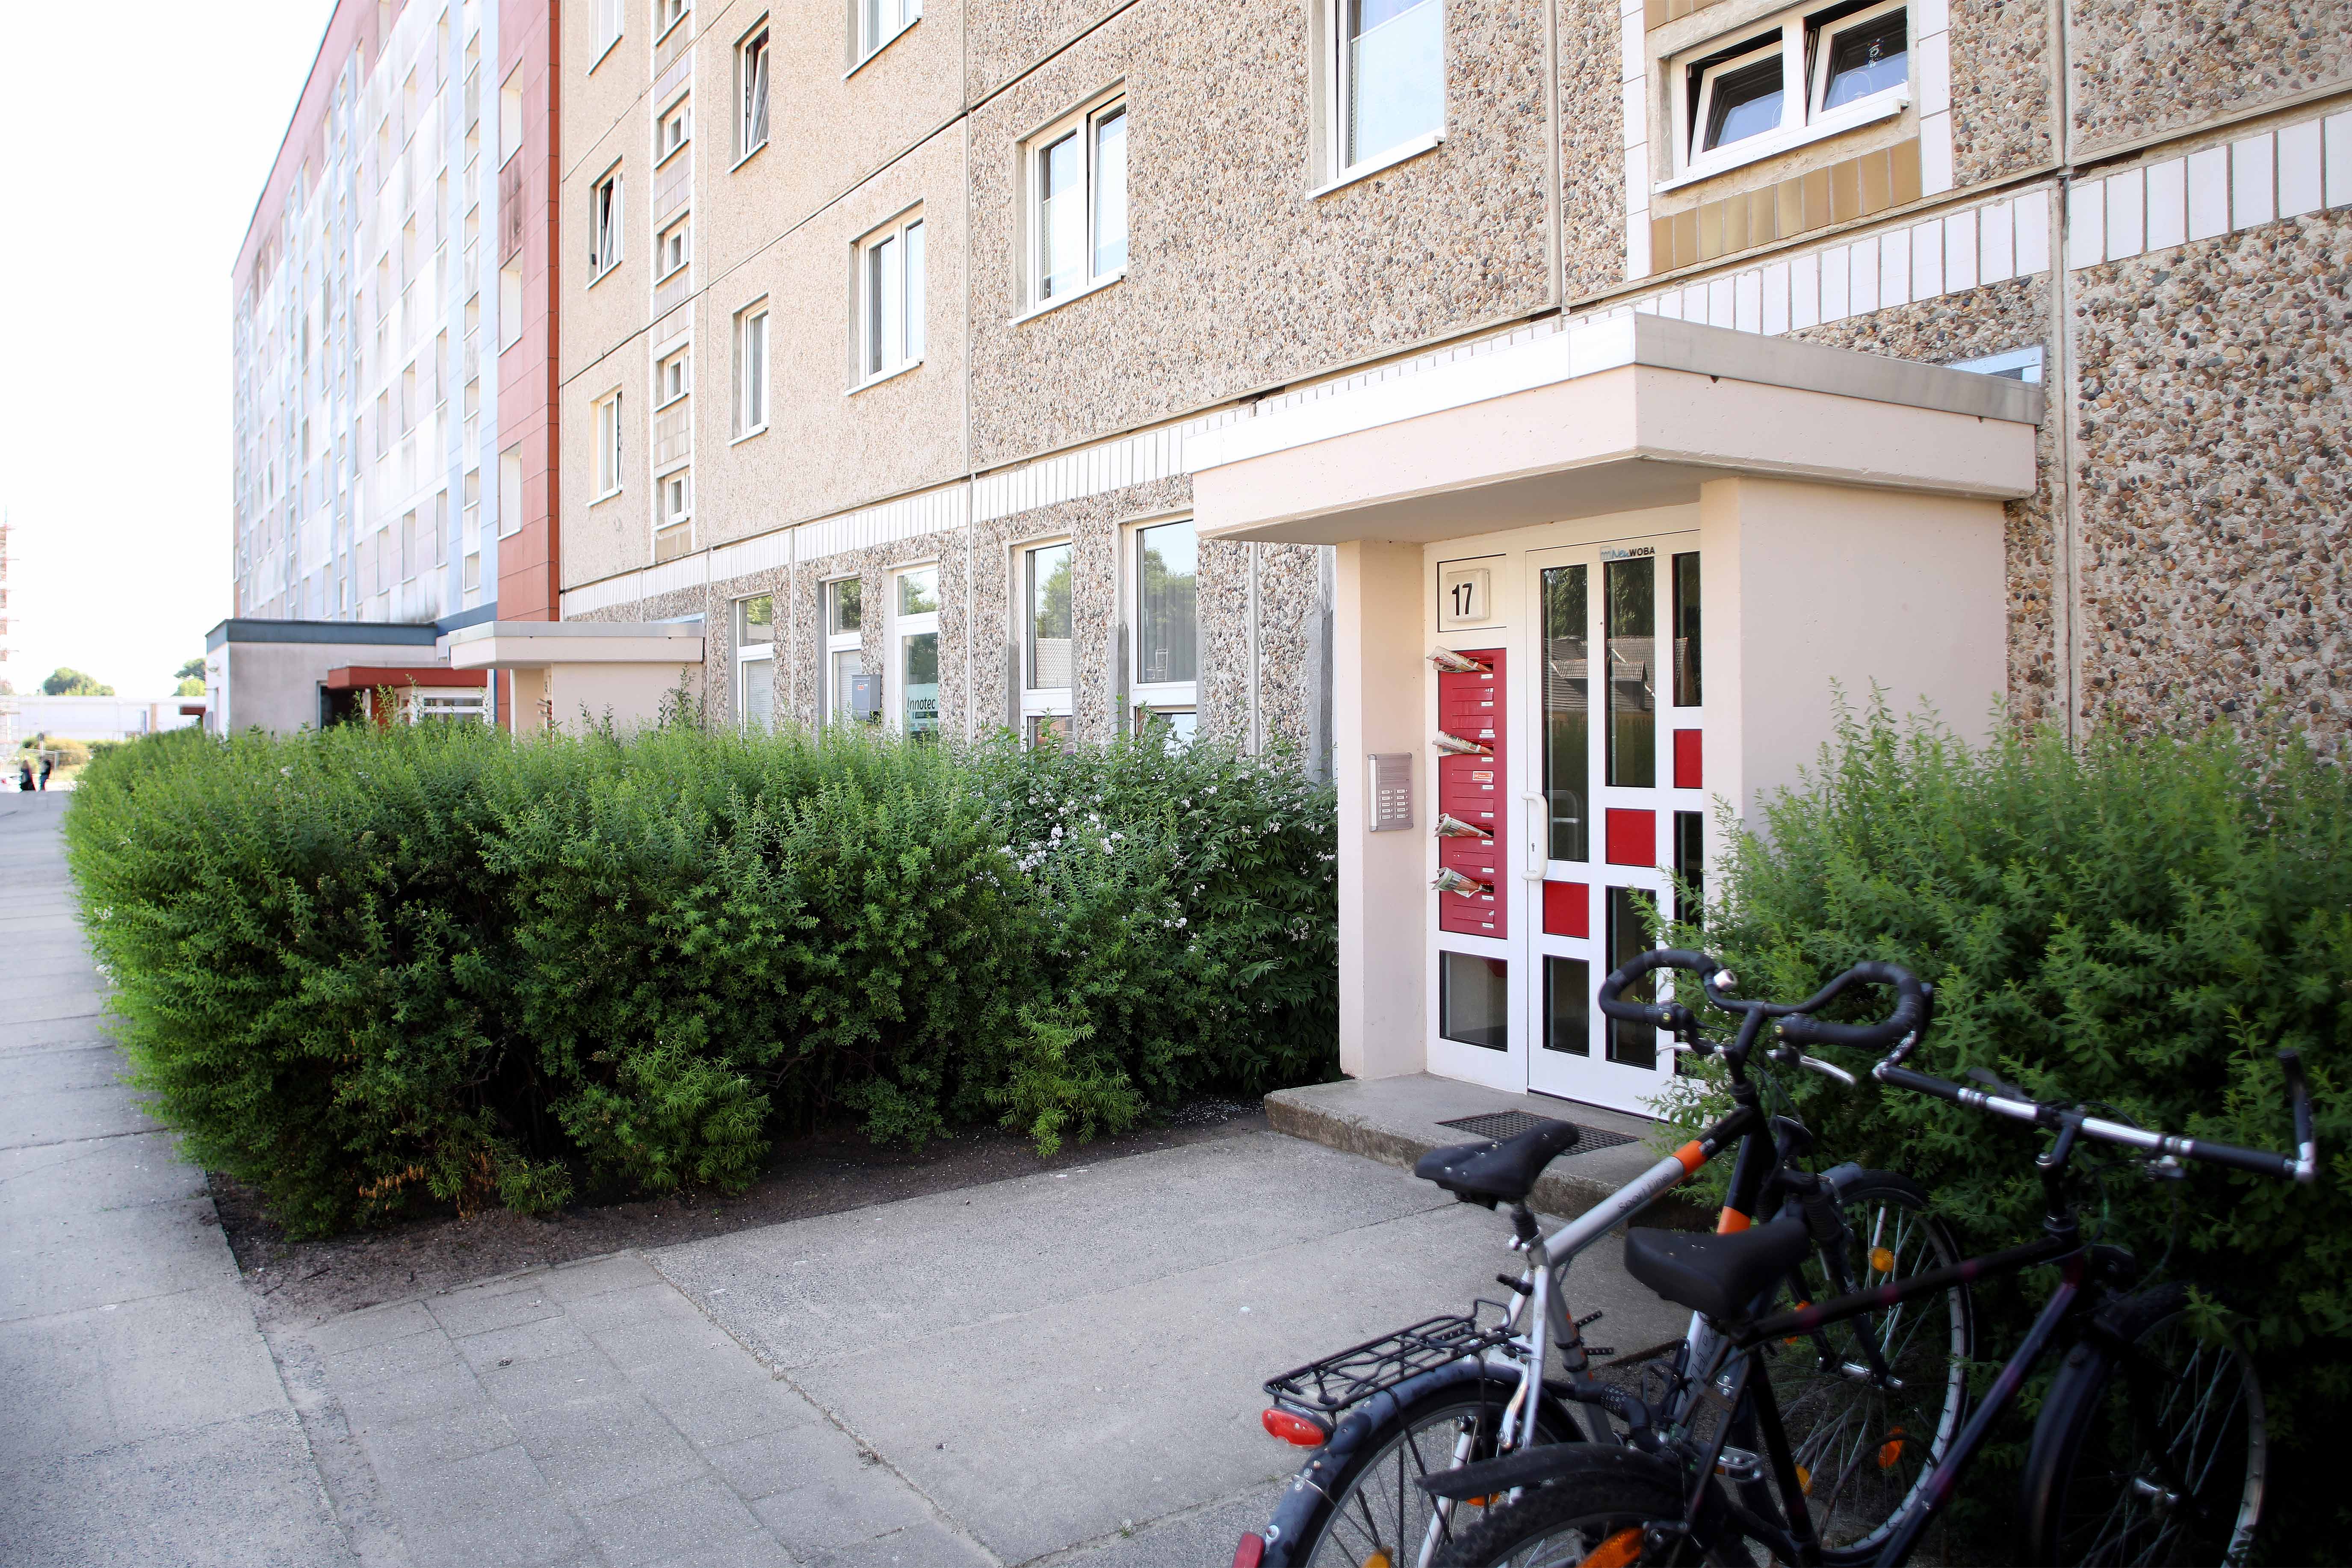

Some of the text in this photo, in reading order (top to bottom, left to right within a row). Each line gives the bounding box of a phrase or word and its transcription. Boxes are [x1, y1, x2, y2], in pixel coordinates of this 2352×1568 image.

[1451, 582, 1472, 616] 17
[1618, 1173, 1669, 1213] Sport Line
